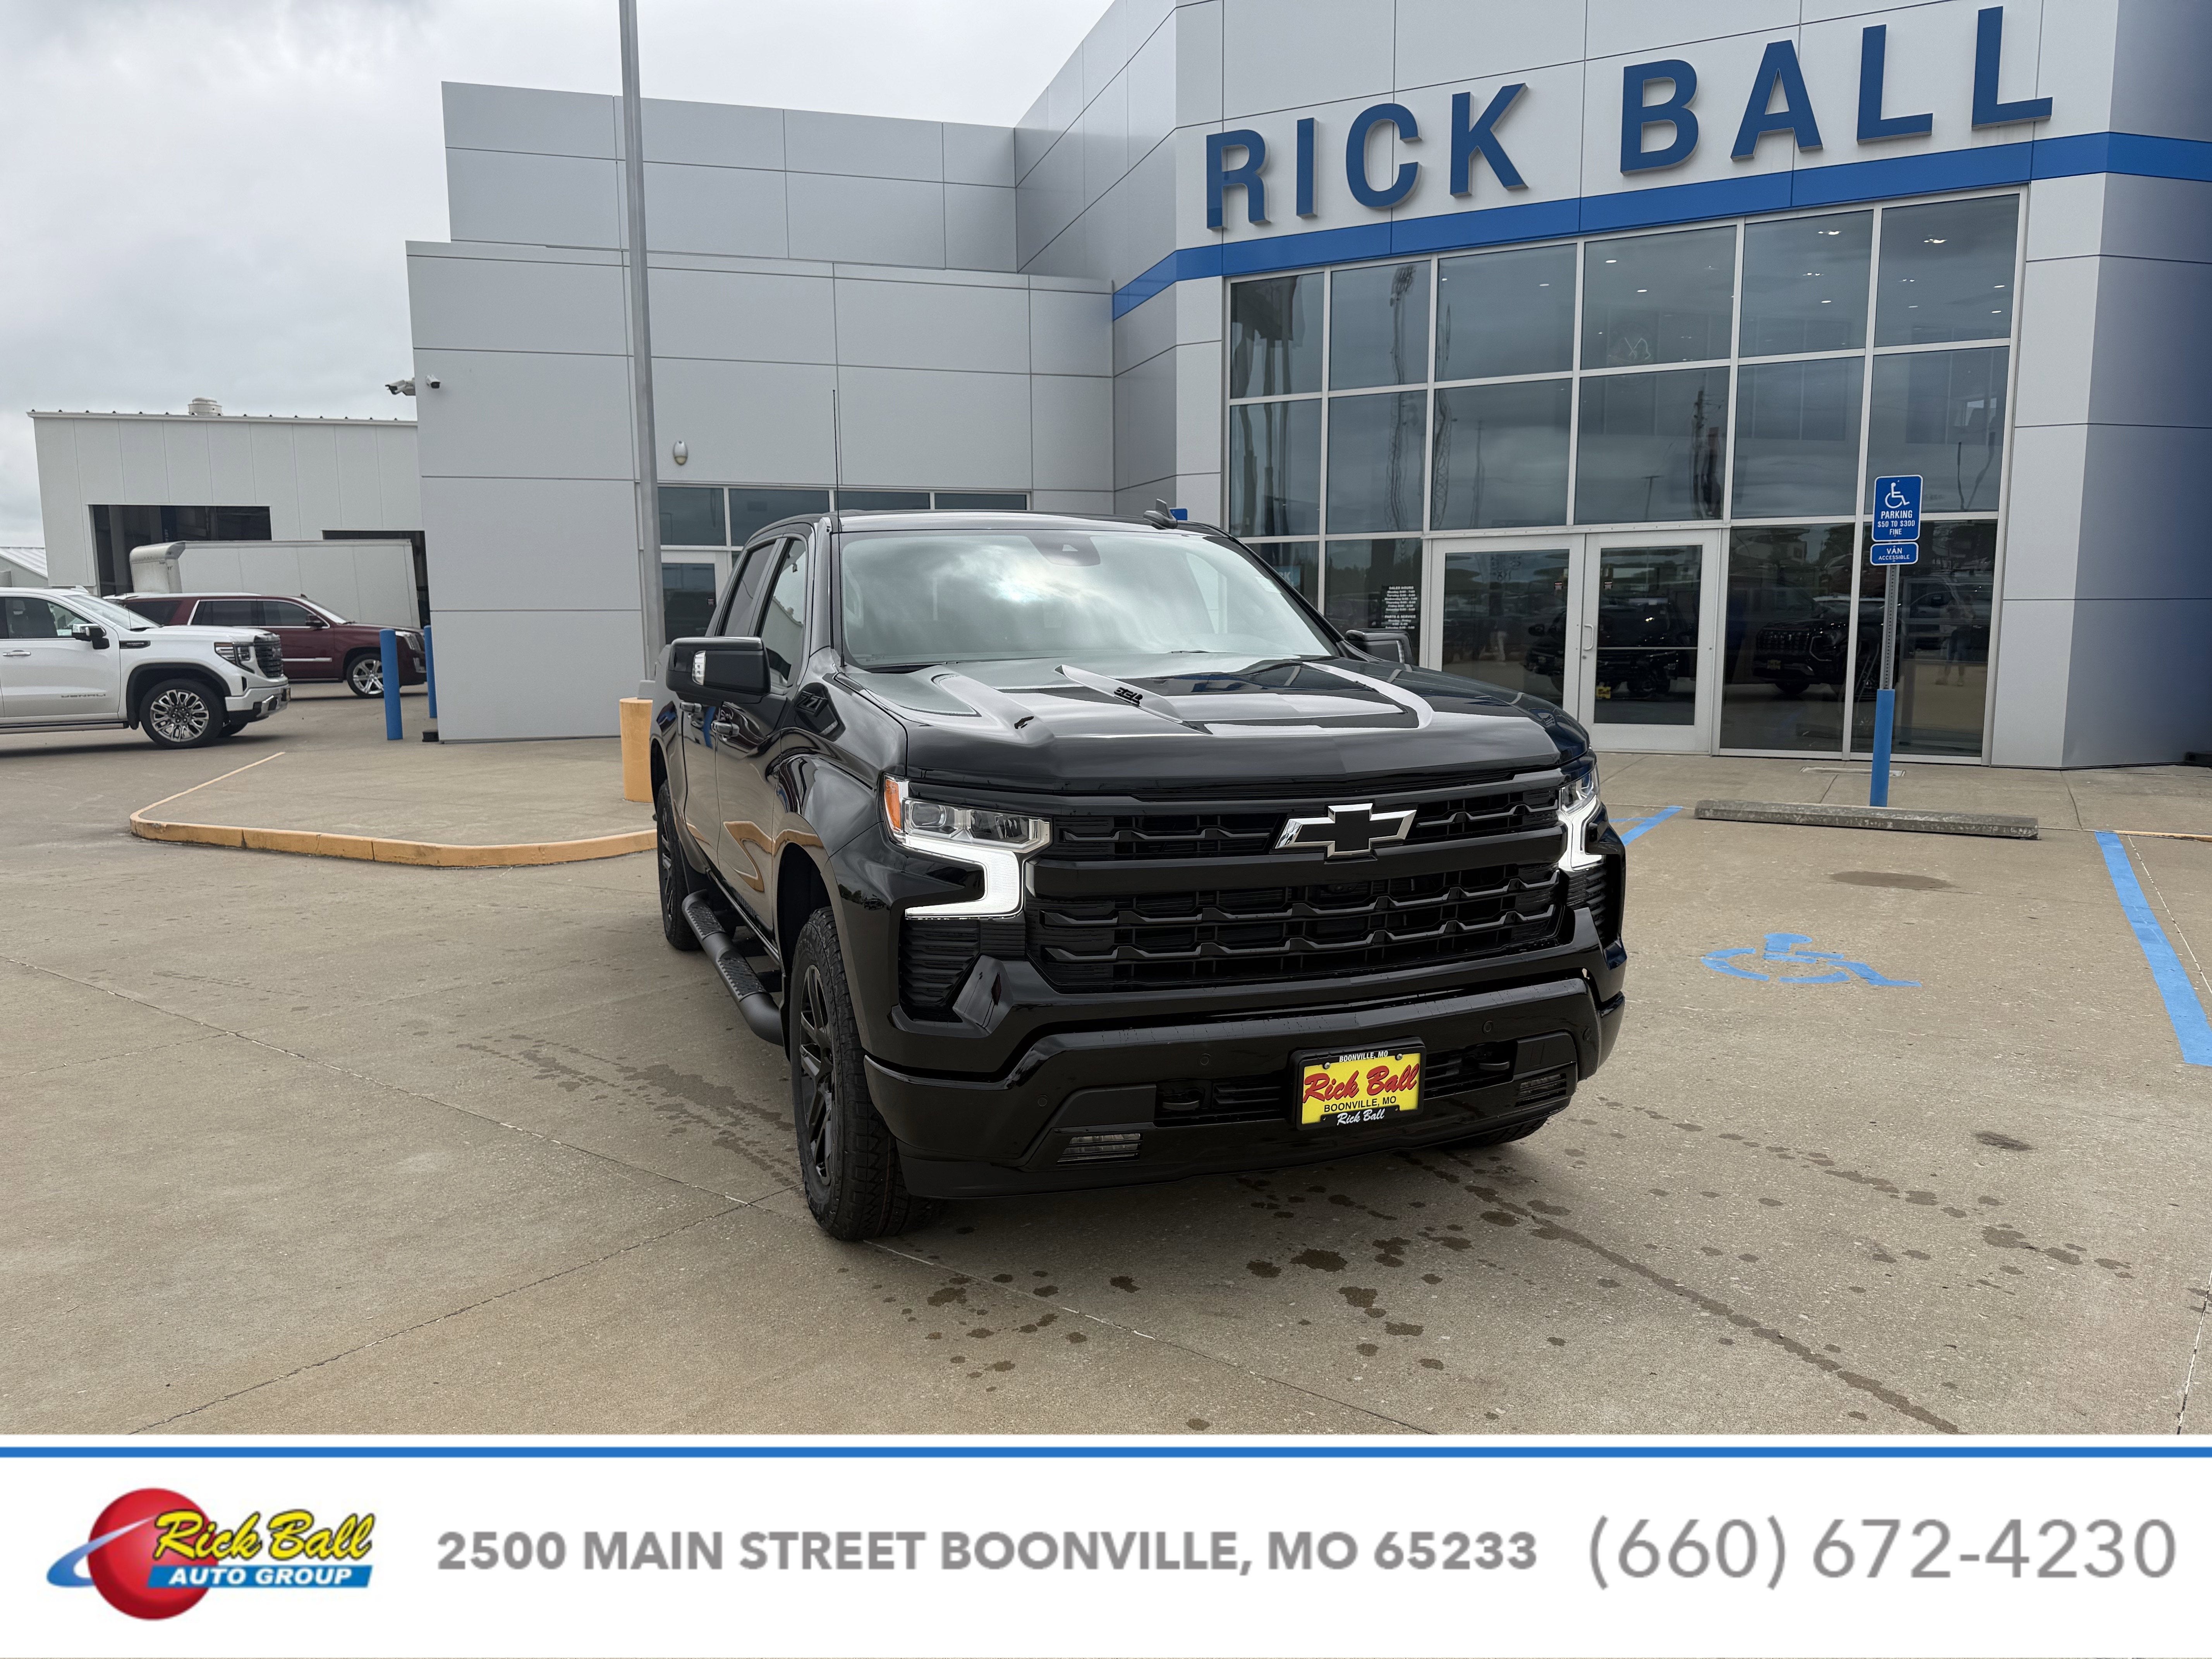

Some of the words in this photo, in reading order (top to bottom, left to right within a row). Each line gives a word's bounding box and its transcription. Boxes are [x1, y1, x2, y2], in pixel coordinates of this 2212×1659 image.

[1207, 83, 1528, 231] RICK
[1621, 7, 2052, 173] BALL
[1881, 510, 1913, 519] PARKING
[1302, 1070, 1360, 1104] Rick
[1366, 1063, 1420, 1096] Ball
[1382, 1096, 1396, 1105] MO
[1337, 1111, 1361, 1125] Rick
[1363, 1108, 1385, 1121] Ball
